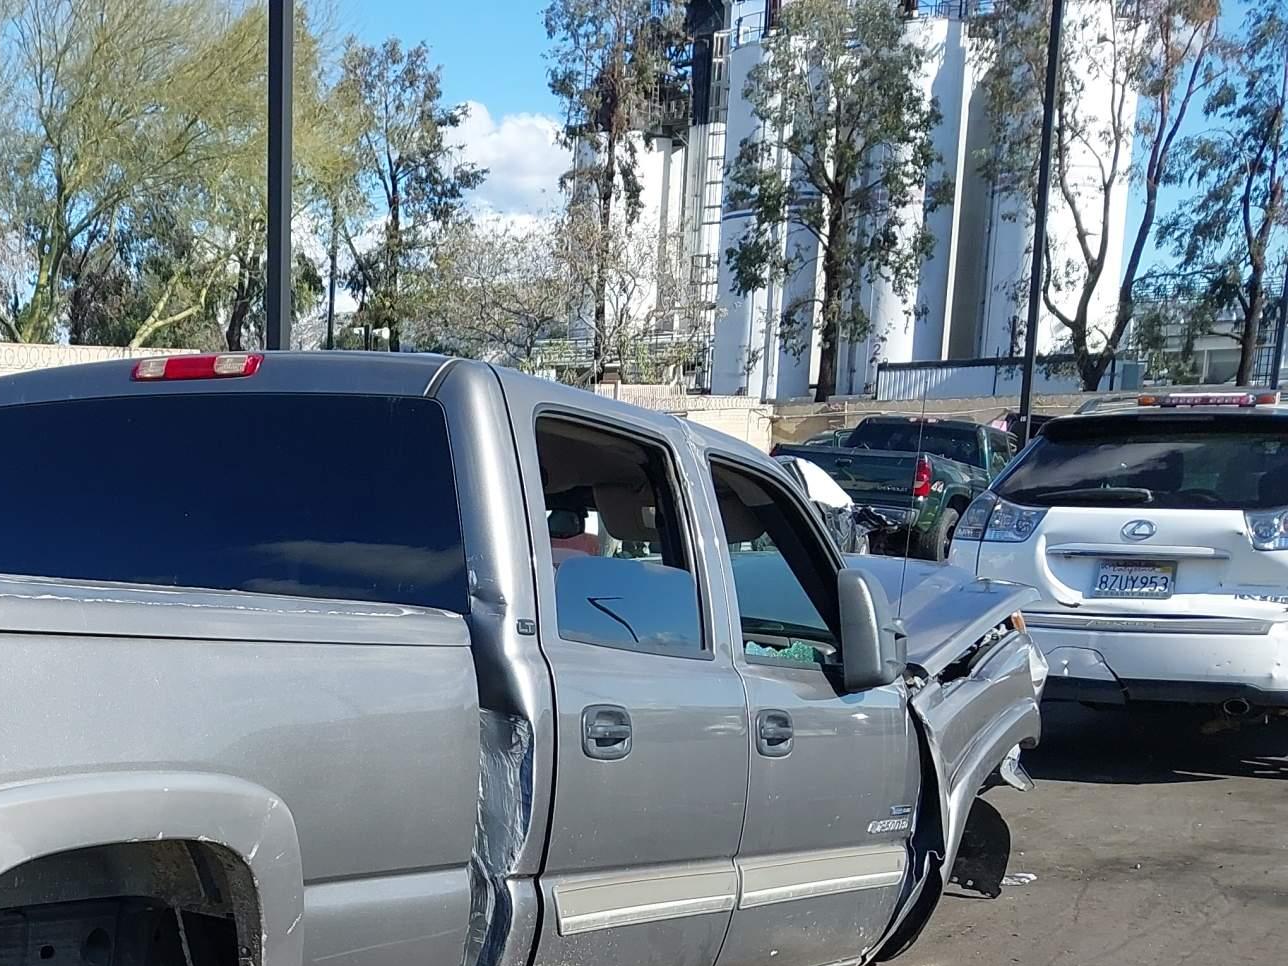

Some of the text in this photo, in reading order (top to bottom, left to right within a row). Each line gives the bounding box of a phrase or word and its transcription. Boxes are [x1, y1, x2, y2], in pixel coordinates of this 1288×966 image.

[873, 343, 881, 356] 2
[1098, 574, 1169, 593] 8ZUY953
[518, 621, 534, 633] LT
